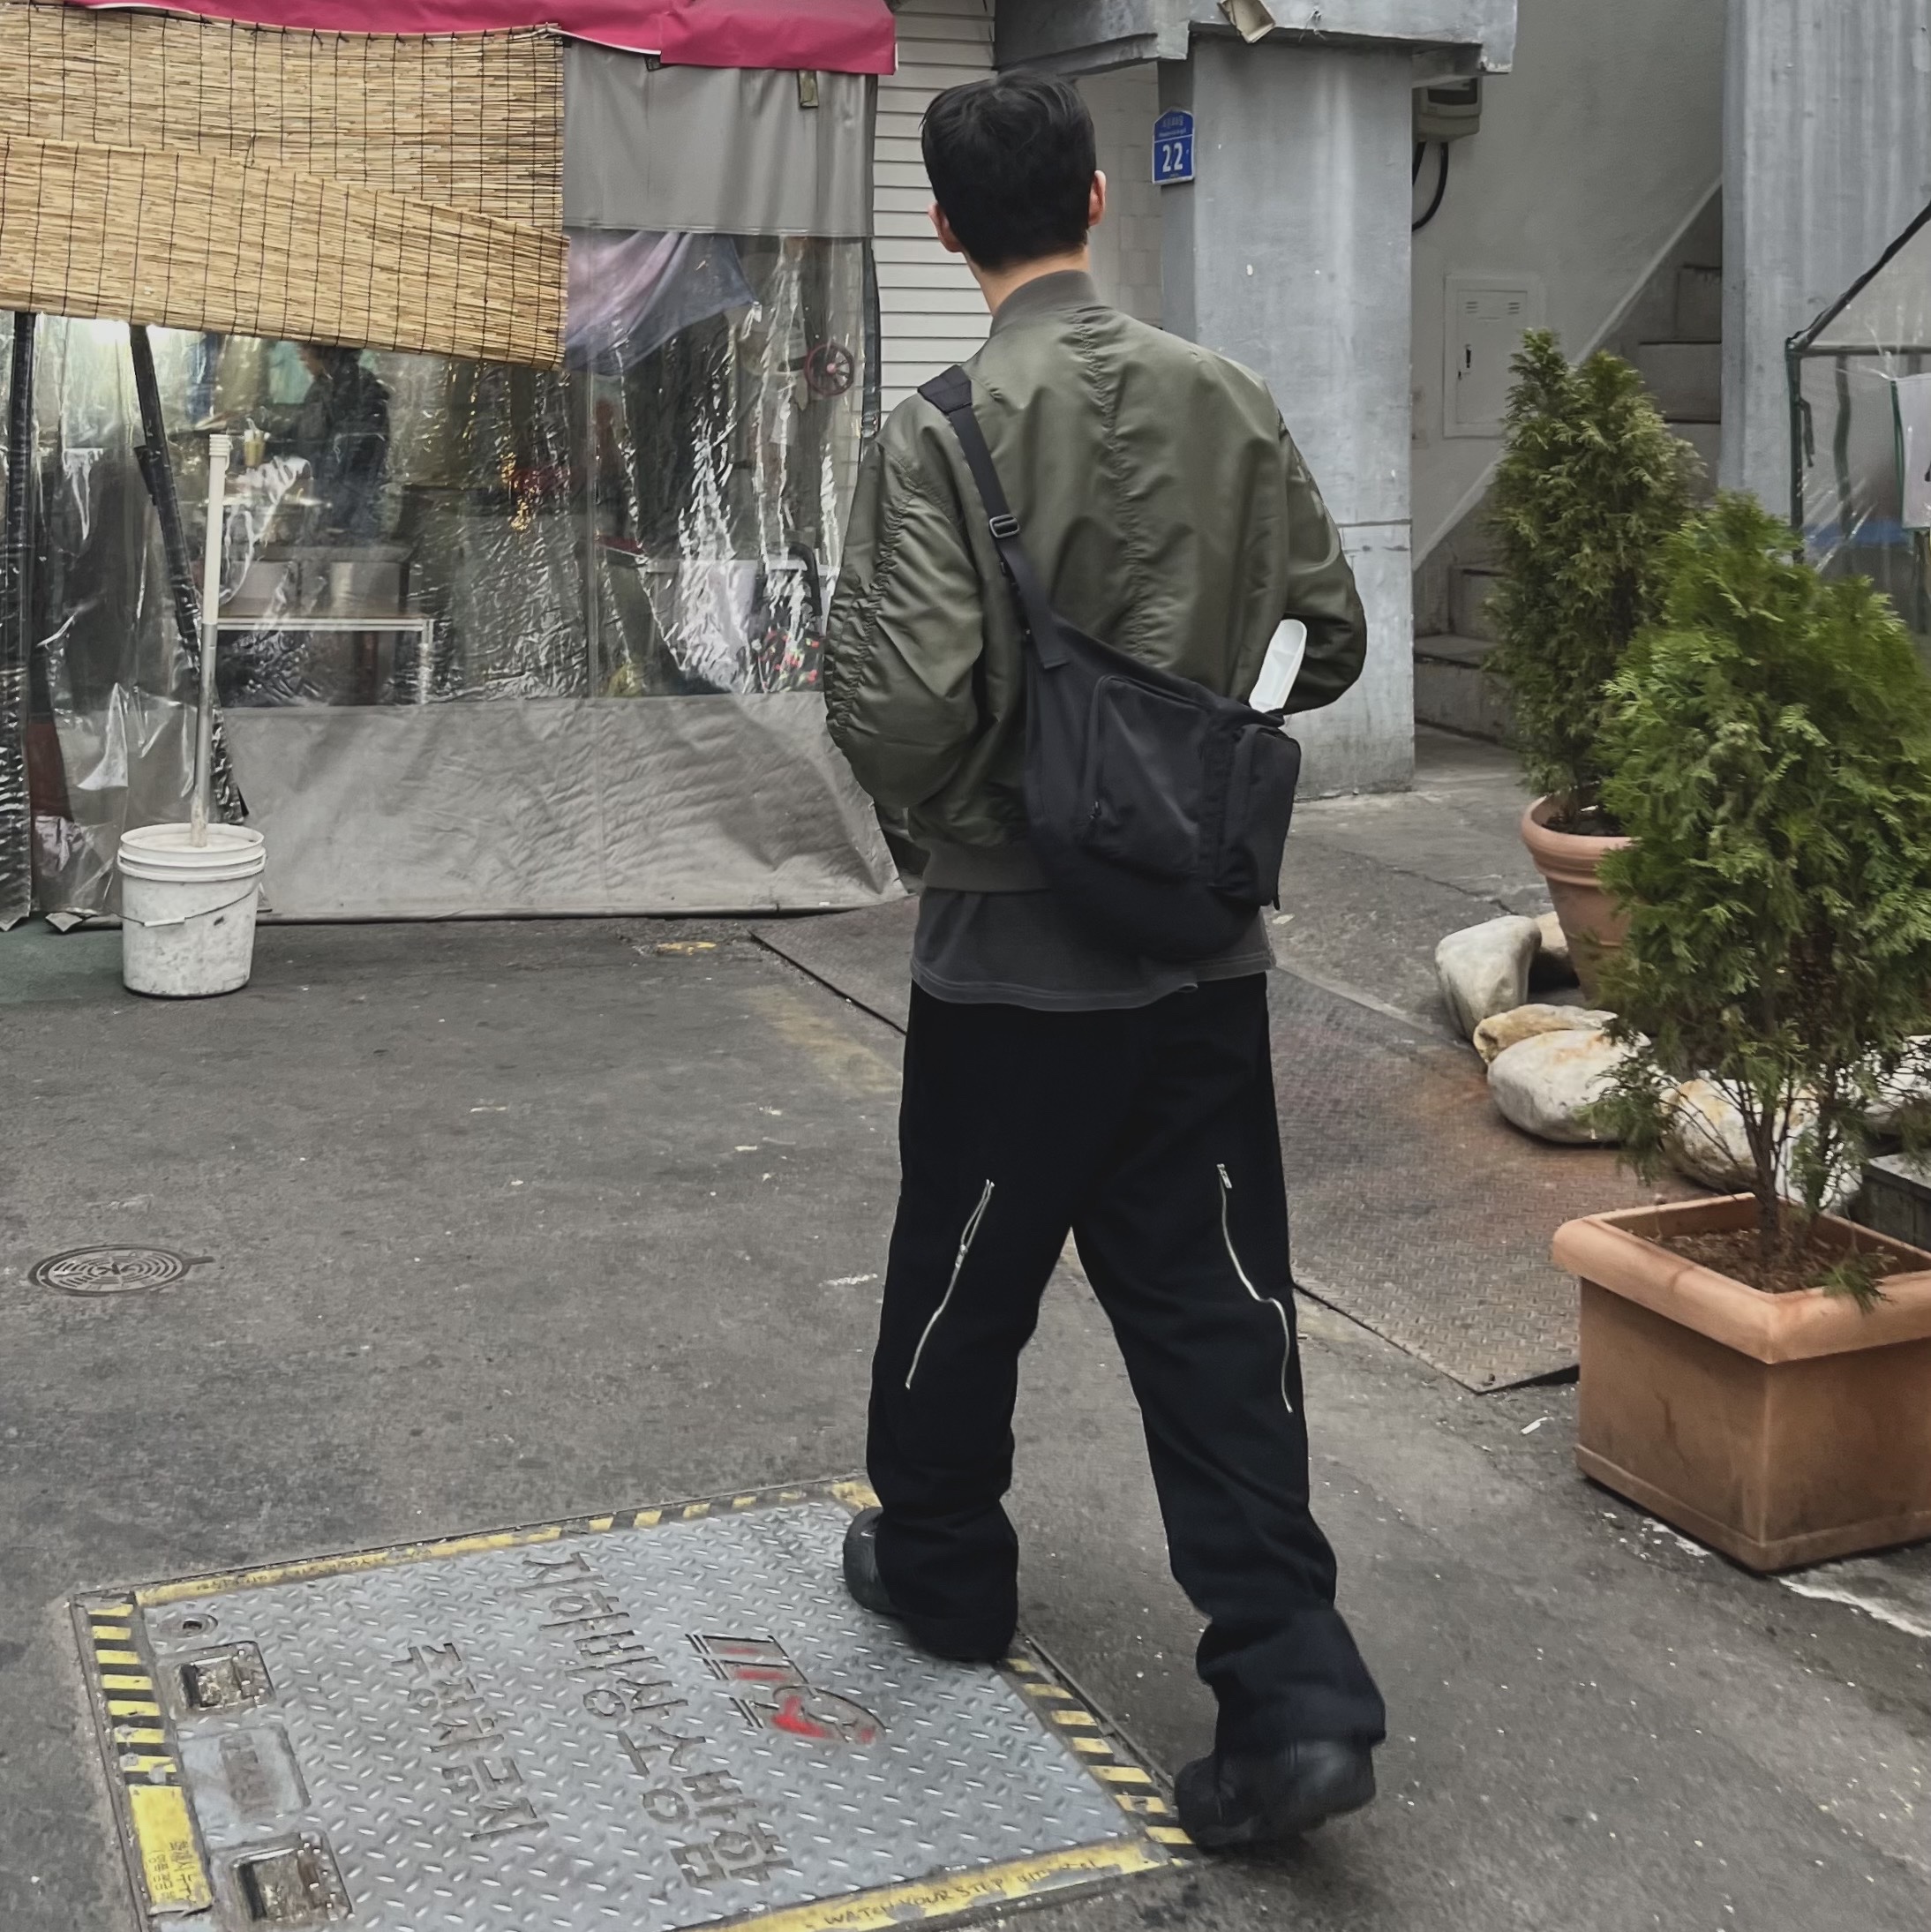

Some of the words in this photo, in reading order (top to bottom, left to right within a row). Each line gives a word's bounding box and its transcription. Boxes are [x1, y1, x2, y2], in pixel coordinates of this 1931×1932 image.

[1162, 142, 1183, 172] 22
[391, 1642, 550, 1841] 주정차금지
[518, 1552, 794, 1889] 지하비상소방함
